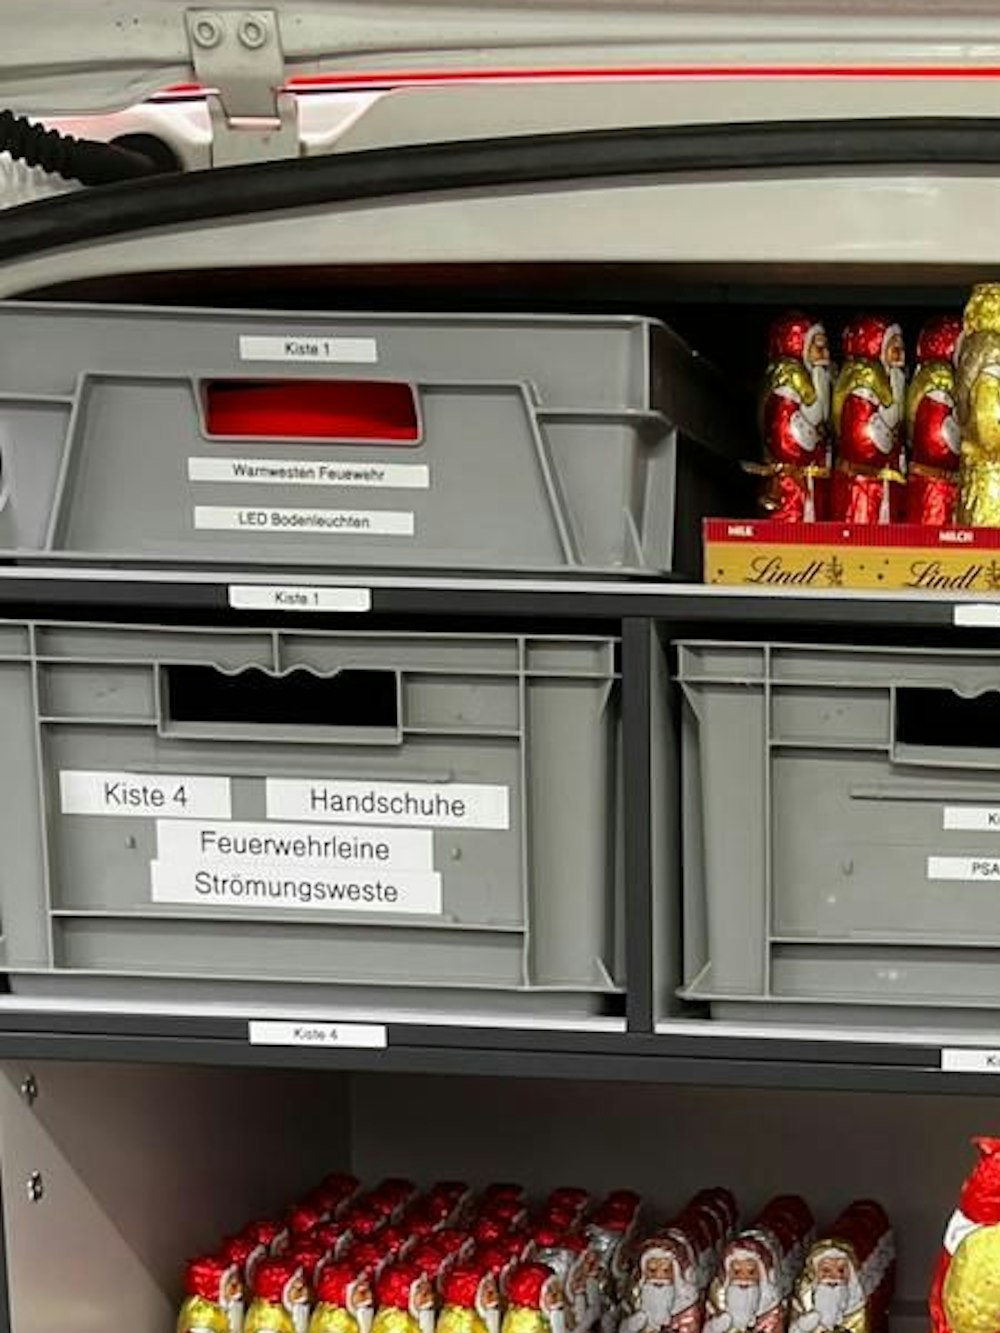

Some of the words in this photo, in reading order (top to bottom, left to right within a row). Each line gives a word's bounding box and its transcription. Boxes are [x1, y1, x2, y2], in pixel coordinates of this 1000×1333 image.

[284, 341, 318, 356] Kiste
[323, 341, 330, 357] 1
[233, 463, 316, 480] Warnwesten
[238, 511, 267, 525] LED
[271, 512, 370, 529] Bodenleuchten
[728, 525, 753, 537] MILK
[939, 530, 974, 542] MILCH
[744, 556, 824, 584] Lindt
[903, 560, 984, 589] Lindt
[275, 591, 308, 605] Kiste
[313, 592, 319, 605] 1
[104, 782, 166, 806] Kiste
[172, 785, 188, 807] 4
[310, 788, 466, 816] Handschuhe
[201, 831, 390, 860] Feuerwehrleine
[972, 862, 1000, 876] PSA
[195, 871, 398, 903] Strömungsweste
[294, 1027, 326, 1040] Kiste
[330, 1028, 338, 1041] 4
